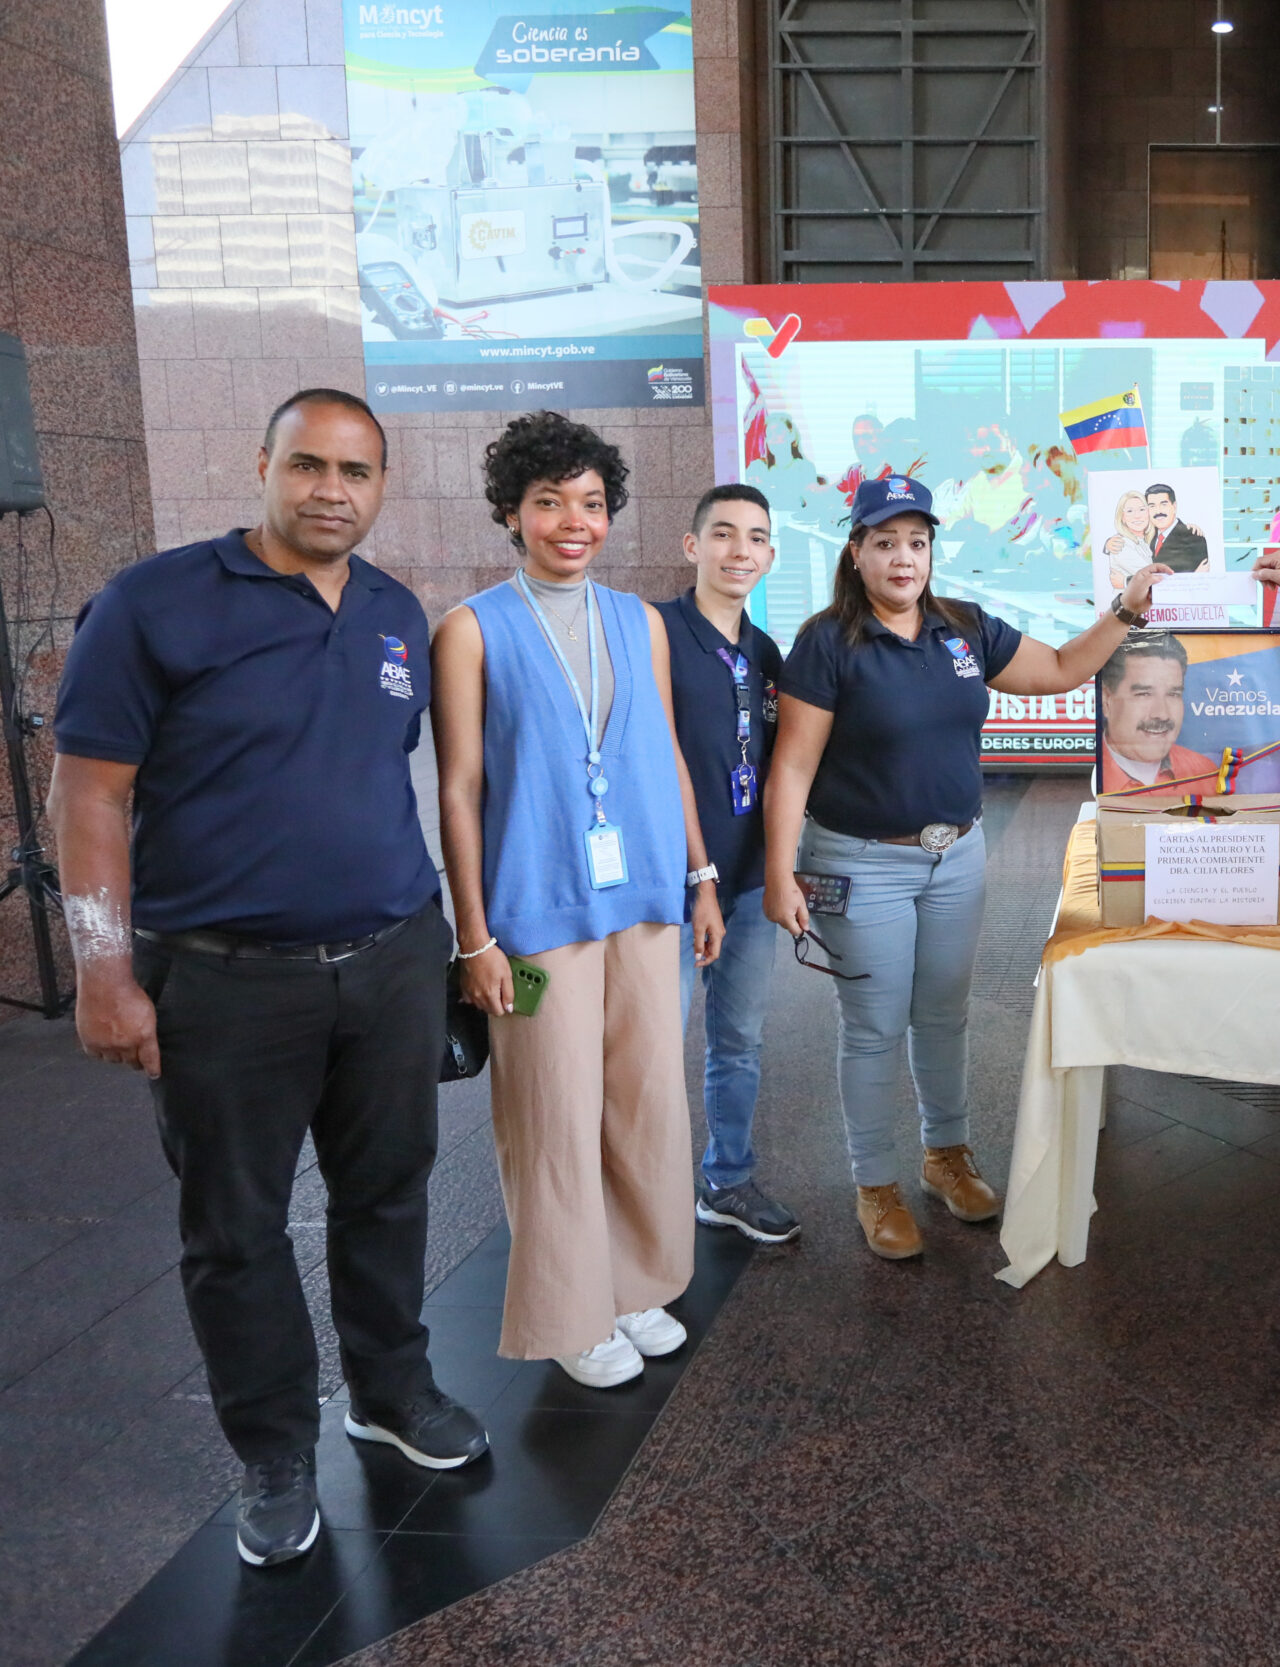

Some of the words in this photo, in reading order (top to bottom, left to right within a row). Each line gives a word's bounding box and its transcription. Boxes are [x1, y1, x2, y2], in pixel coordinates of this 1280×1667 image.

[512, 21, 568, 43] Ciencia
[575, 26, 588, 41] es
[496, 40, 640, 63] soberanía
[480, 344, 596, 358] www.mincyt.gob.ve
[527, 381, 564, 390] MincytVE
[672, 385, 692, 394] 200
[1206, 688, 1267, 702] Vamos
[1034, 738, 1096, 750] EUROPE
[1159, 835, 1195, 843] CARTAS
[1196, 835, 1209, 843] AL
[1210, 835, 1266, 843] PRESIDENTE
[1202, 846, 1243, 854] MADURO
[1199, 856, 1265, 864] COMBATIENTE
[1170, 867, 1191, 875] DRA.
[1193, 867, 1218, 875] CILIA
[1220, 866, 1255, 874] FLORES
